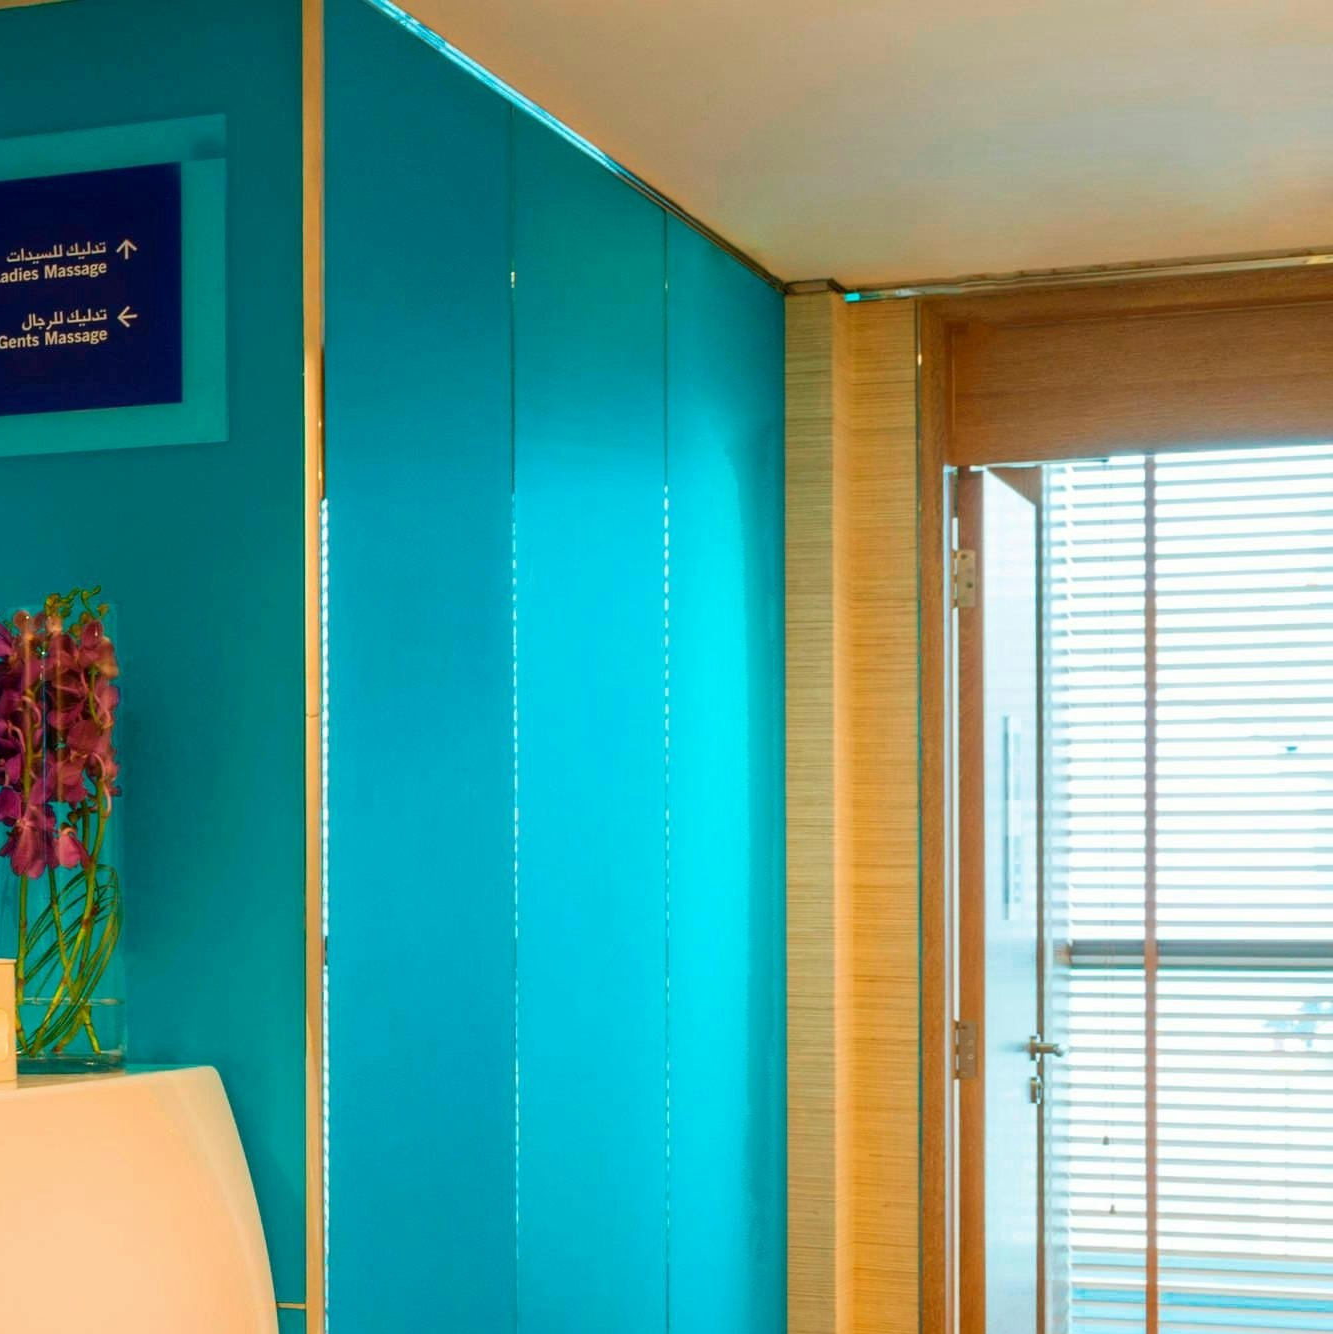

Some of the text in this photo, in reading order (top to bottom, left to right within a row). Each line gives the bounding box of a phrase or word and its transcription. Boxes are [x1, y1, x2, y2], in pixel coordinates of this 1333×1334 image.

[6, 242, 106, 264] تدليك للسيدات
[44, 263, 107, 279] Massage
[22, 309, 107, 330] تدليك للرجال
[45, 330, 108, 345] Massage
